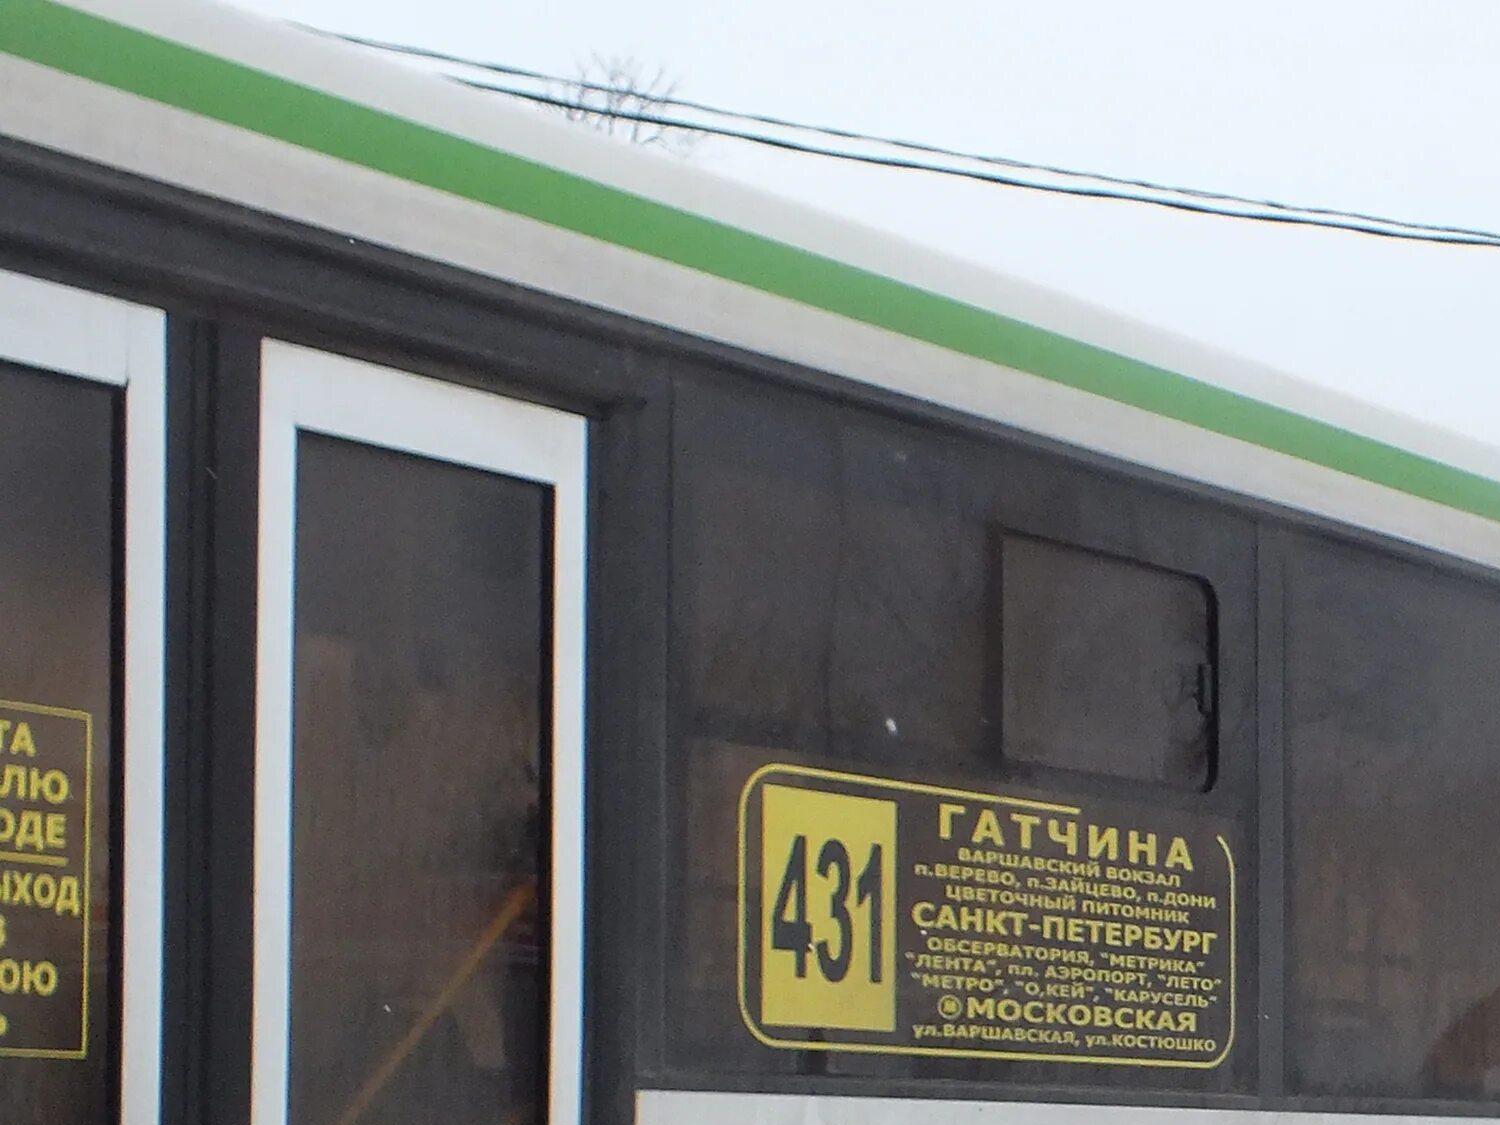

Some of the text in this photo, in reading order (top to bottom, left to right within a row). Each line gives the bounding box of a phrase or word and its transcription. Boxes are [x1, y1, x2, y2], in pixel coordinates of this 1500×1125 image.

[939, 803, 1194, 871] ГАТЧИНА
[914, 864, 1217, 909] п.ВЕРЕВО, п.ЗАЙЦЕВО, п.ДОНИ
[958, 847, 1181, 887] ВАРШАВСКИЙ ВОКЗАЛ
[772, 835, 882, 983] 431
[946, 885, 1190, 924] ЦВЕТОЧНЫЙ ПИТОМНИК
[911, 902, 1218, 954] САНКТ-ПЕТЕРБУРГ
[926, 936, 1094, 966] ОБСЕРВАТОРИЯ,
[1045, 964, 1152, 989] АЭРОПОРТ,
[967, 996, 1197, 1032] МОСКОВСКАЯ
[1086, 1032, 1217, 1052] ул.КОСТЮШКО
